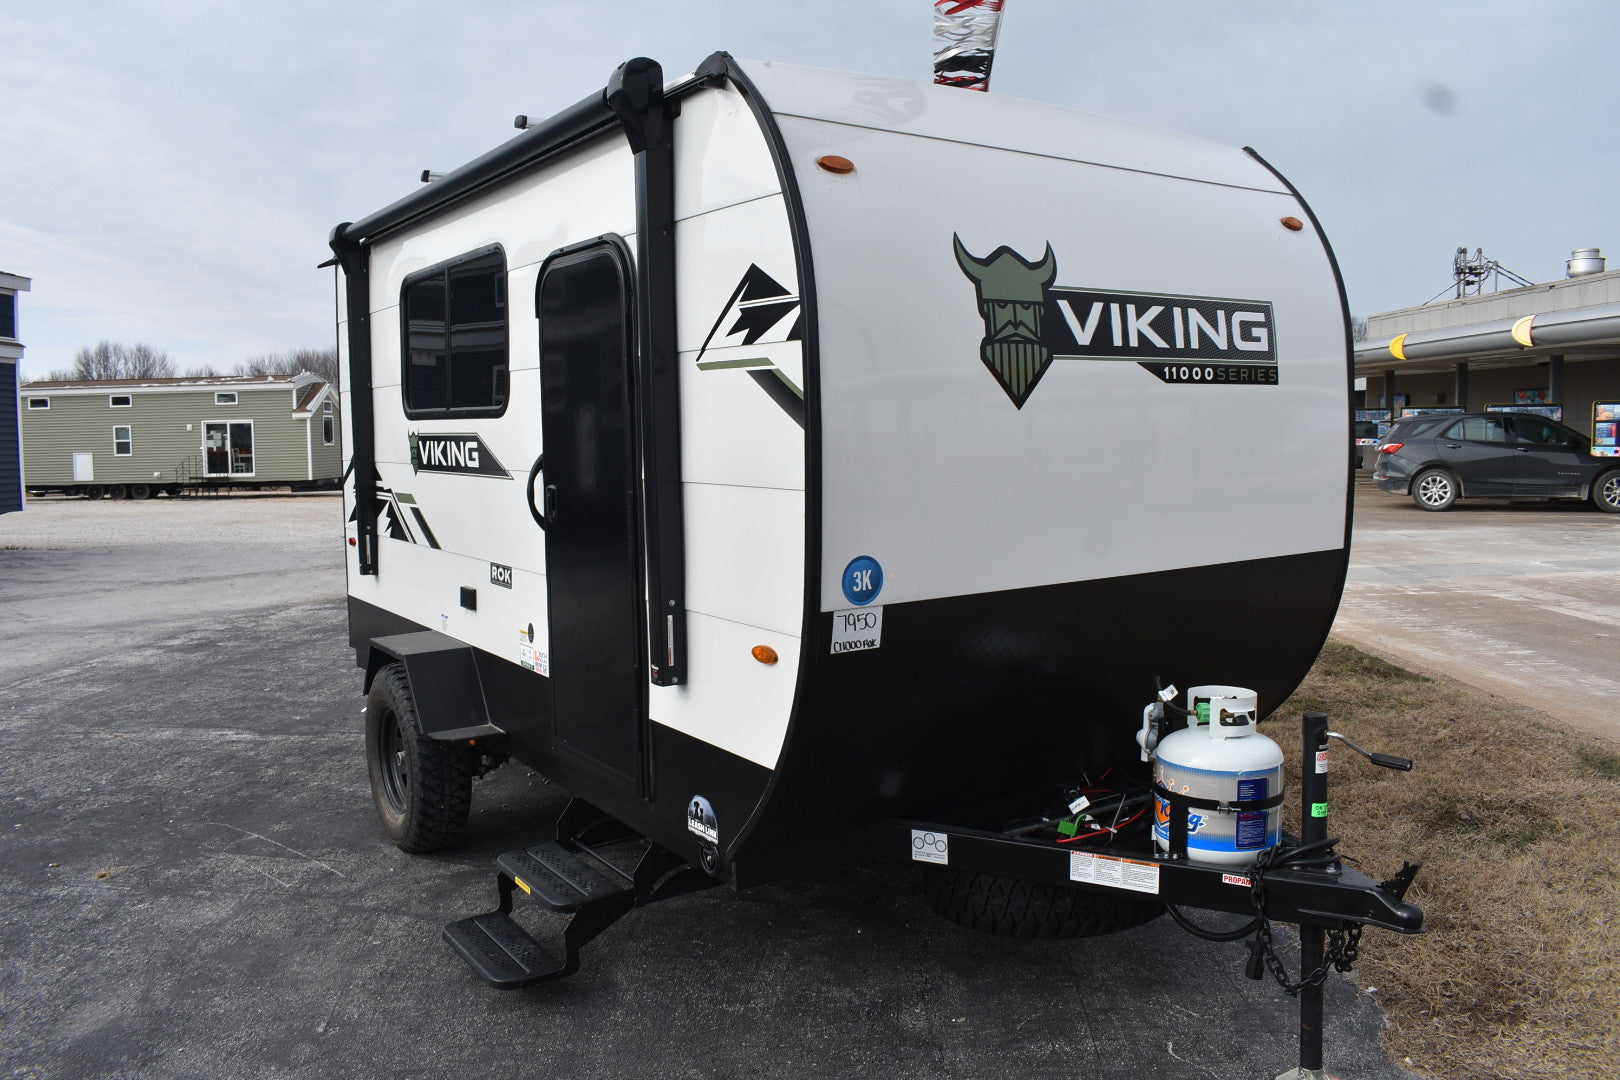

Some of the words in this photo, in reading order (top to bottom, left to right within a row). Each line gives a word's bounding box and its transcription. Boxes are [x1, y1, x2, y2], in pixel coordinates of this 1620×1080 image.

[1056, 299, 1269, 352] VIKING
[1163, 366, 1214, 381] 11000
[1216, 367, 1278, 383] SERIES
[418, 440, 481, 468] VIKING
[491, 565, 511, 584] ROK
[852, 569, 873, 592] 3K
[1223, 875, 1252, 887] PROPAN
